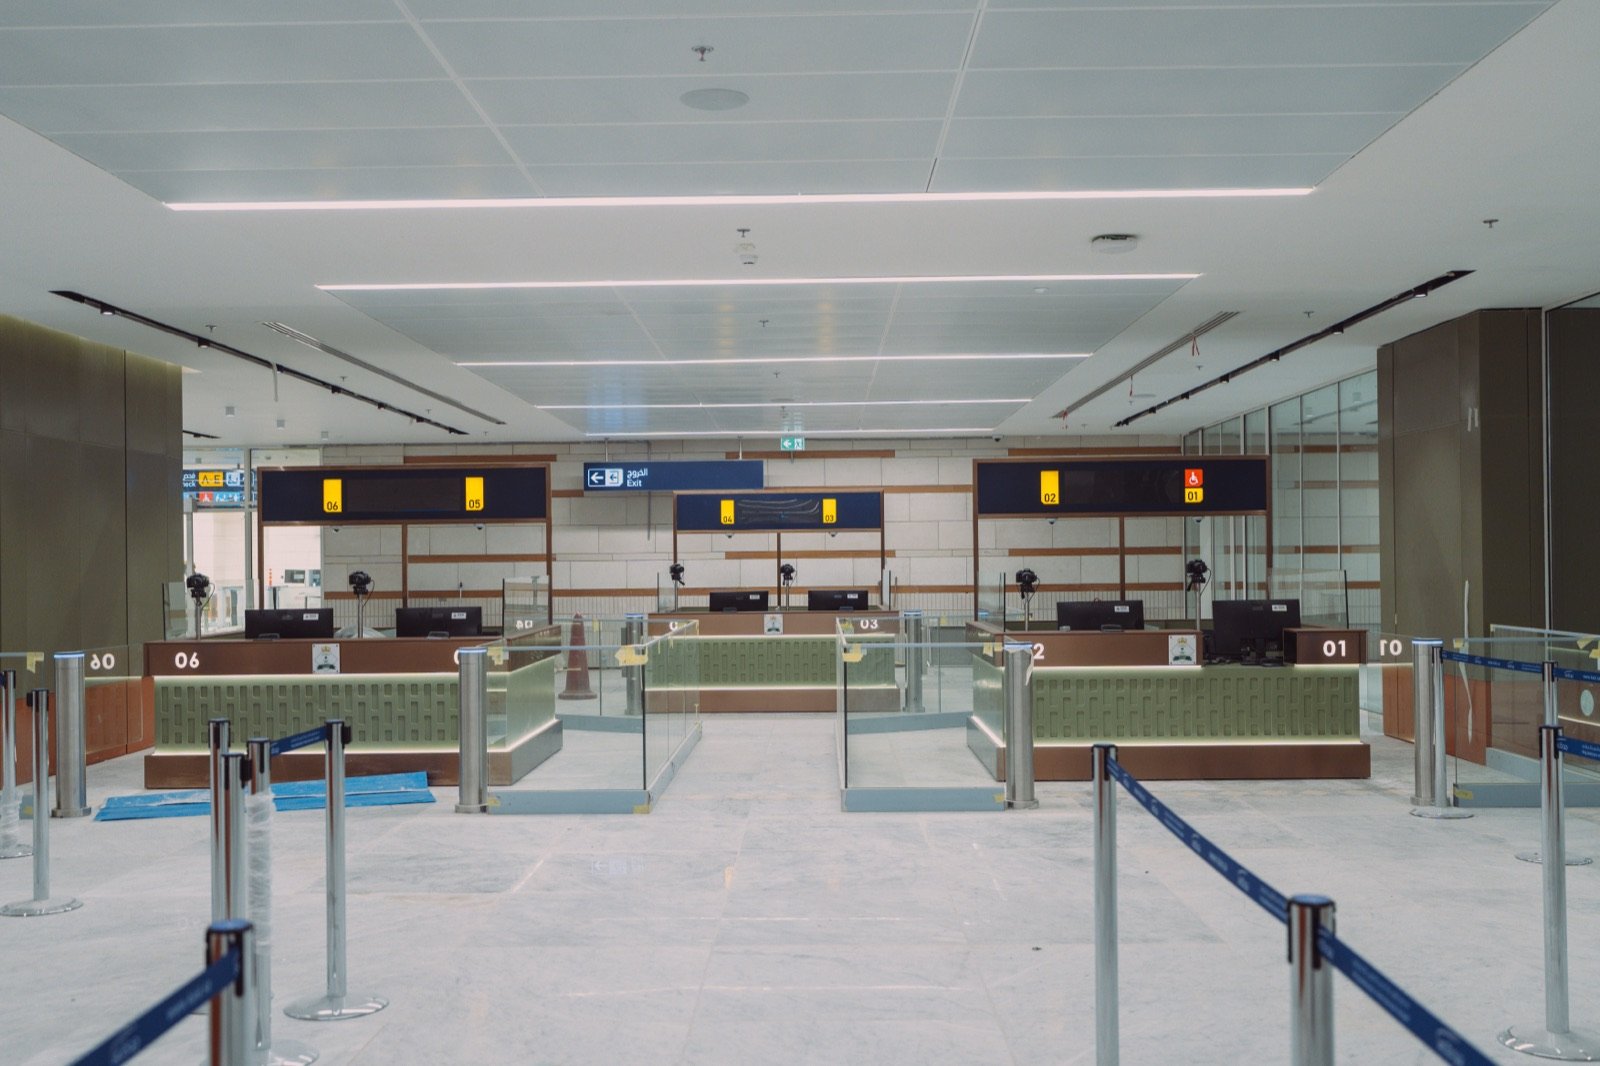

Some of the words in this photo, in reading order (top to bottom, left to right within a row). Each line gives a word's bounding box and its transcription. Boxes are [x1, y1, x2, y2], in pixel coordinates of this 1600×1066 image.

[627, 468, 648, 479] الخروج
[627, 479, 642, 487] Exit
[1044, 493, 1056, 503] 02
[1187, 491, 1198, 501] 01
[326, 501, 339, 511] 06
[468, 499, 481, 509] 05
[825, 514, 834, 522] 03
[860, 618, 879, 630] 03
[1033, 643, 1045, 660] 2
[1323, 639, 1346, 657] 01
[174, 652, 200, 669] 06
